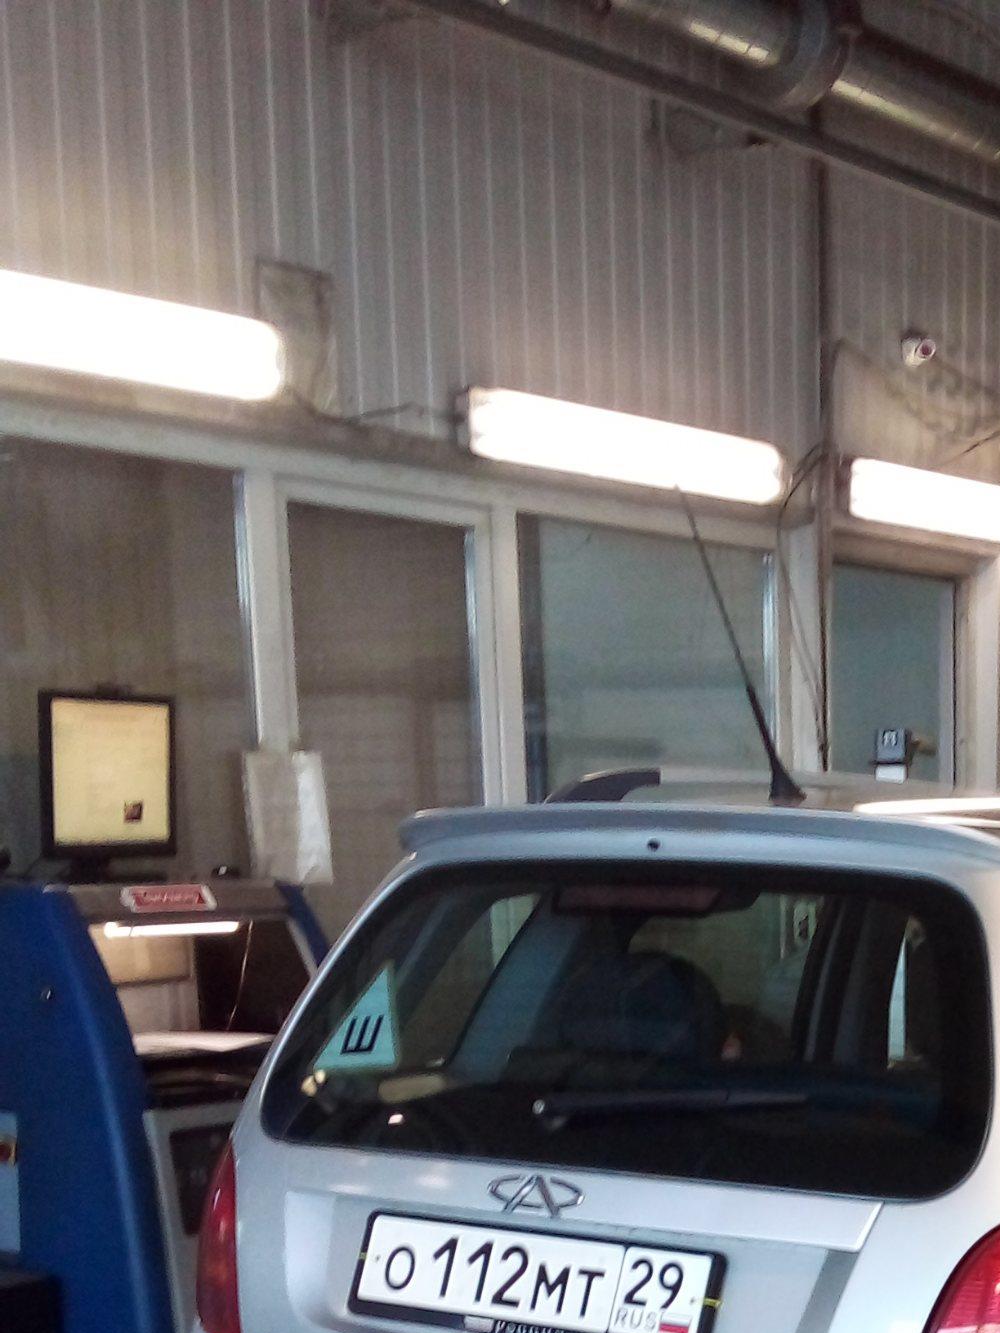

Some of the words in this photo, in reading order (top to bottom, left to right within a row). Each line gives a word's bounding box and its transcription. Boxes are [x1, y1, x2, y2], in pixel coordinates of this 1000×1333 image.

[340, 1014, 384, 1054] Ш
[623, 1258, 684, 1310] 29
[614, 1308, 657, 1332] RUS
